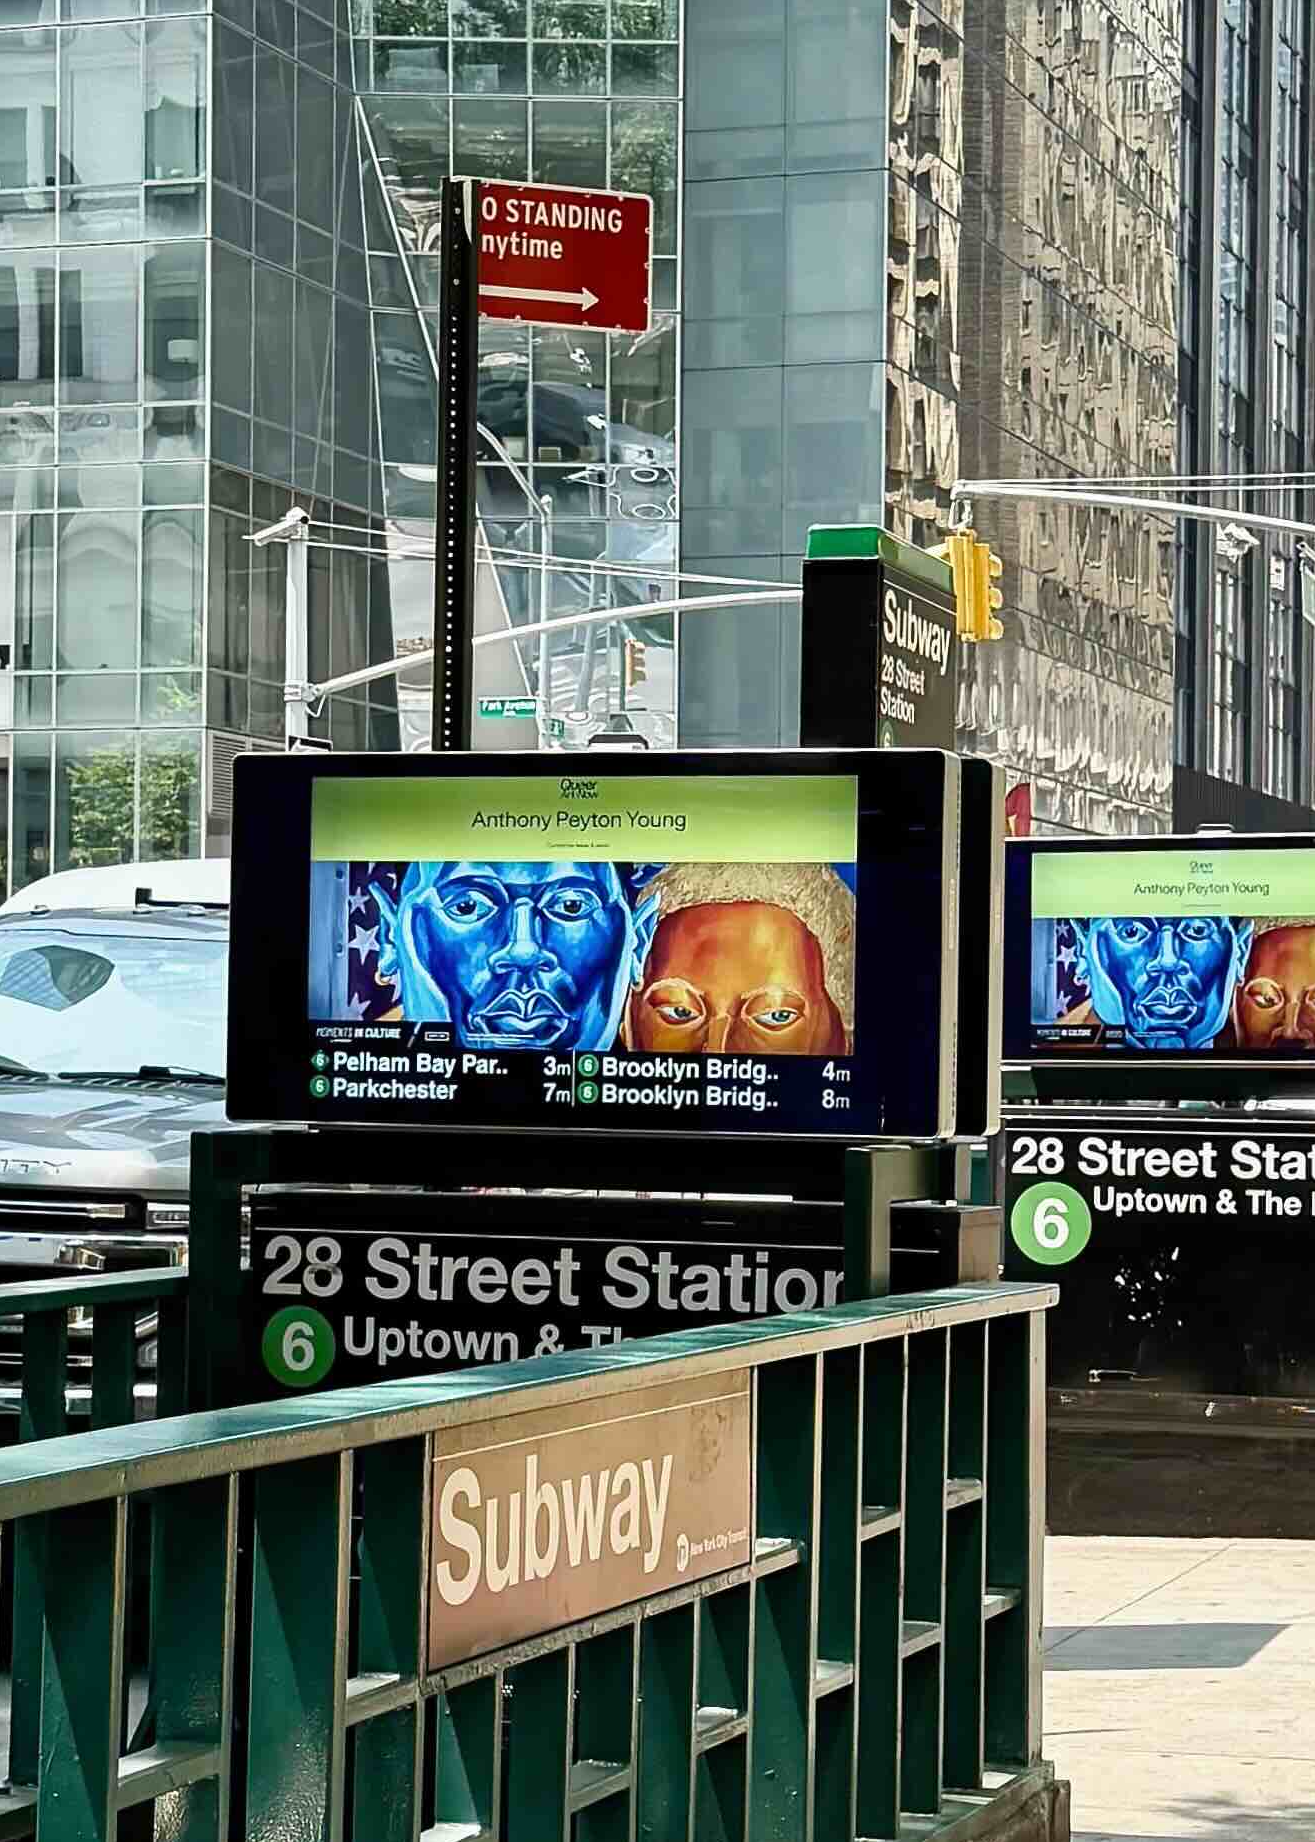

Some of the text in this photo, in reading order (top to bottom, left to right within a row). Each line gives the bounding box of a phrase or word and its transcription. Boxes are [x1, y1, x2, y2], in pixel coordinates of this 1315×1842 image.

[481, 196, 623, 234] O STANDING
[481, 231, 563, 260] nytime
[883, 589, 951, 676] Subway
[881, 654, 926, 696] 28 Street
[880, 685, 915, 725] Station
[471, 810, 687, 833] Anthony Peyton Young
[1133, 881, 1270, 897] Anthony Peyton Young
[333, 1050, 410, 1072] Pelham
[416, 1052, 458, 1078] Bay
[543, 1057, 571, 1077] 3m
[602, 1056, 700, 1084] Brooklyn
[706, 1058, 779, 1084] Bridg..
[821, 1061, 851, 1082] 4m
[332, 1077, 458, 1100] Parkchester
[543, 1083, 571, 1103] 7m
[602, 1081, 700, 1108] Brooklyn
[706, 1084, 779, 1110] Bridg..
[821, 1086, 850, 1109] 8m
[1011, 1136, 1065, 1175] 28
[1078, 1137, 1218, 1178] Street
[1093, 1185, 1207, 1217] Uptown
[1216, 1188, 1238, 1215] &
[1245, 1189, 1302, 1218] The
[1032, 1197, 1070, 1249] 6
[261, 1235, 343, 1298] 28
[365, 1237, 581, 1307] Street
[281, 1321, 316, 1372] 6
[343, 1314, 519, 1366] Uptown
[535, 1323, 564, 1359] &
[436, 1454, 673, 1606] Subway
